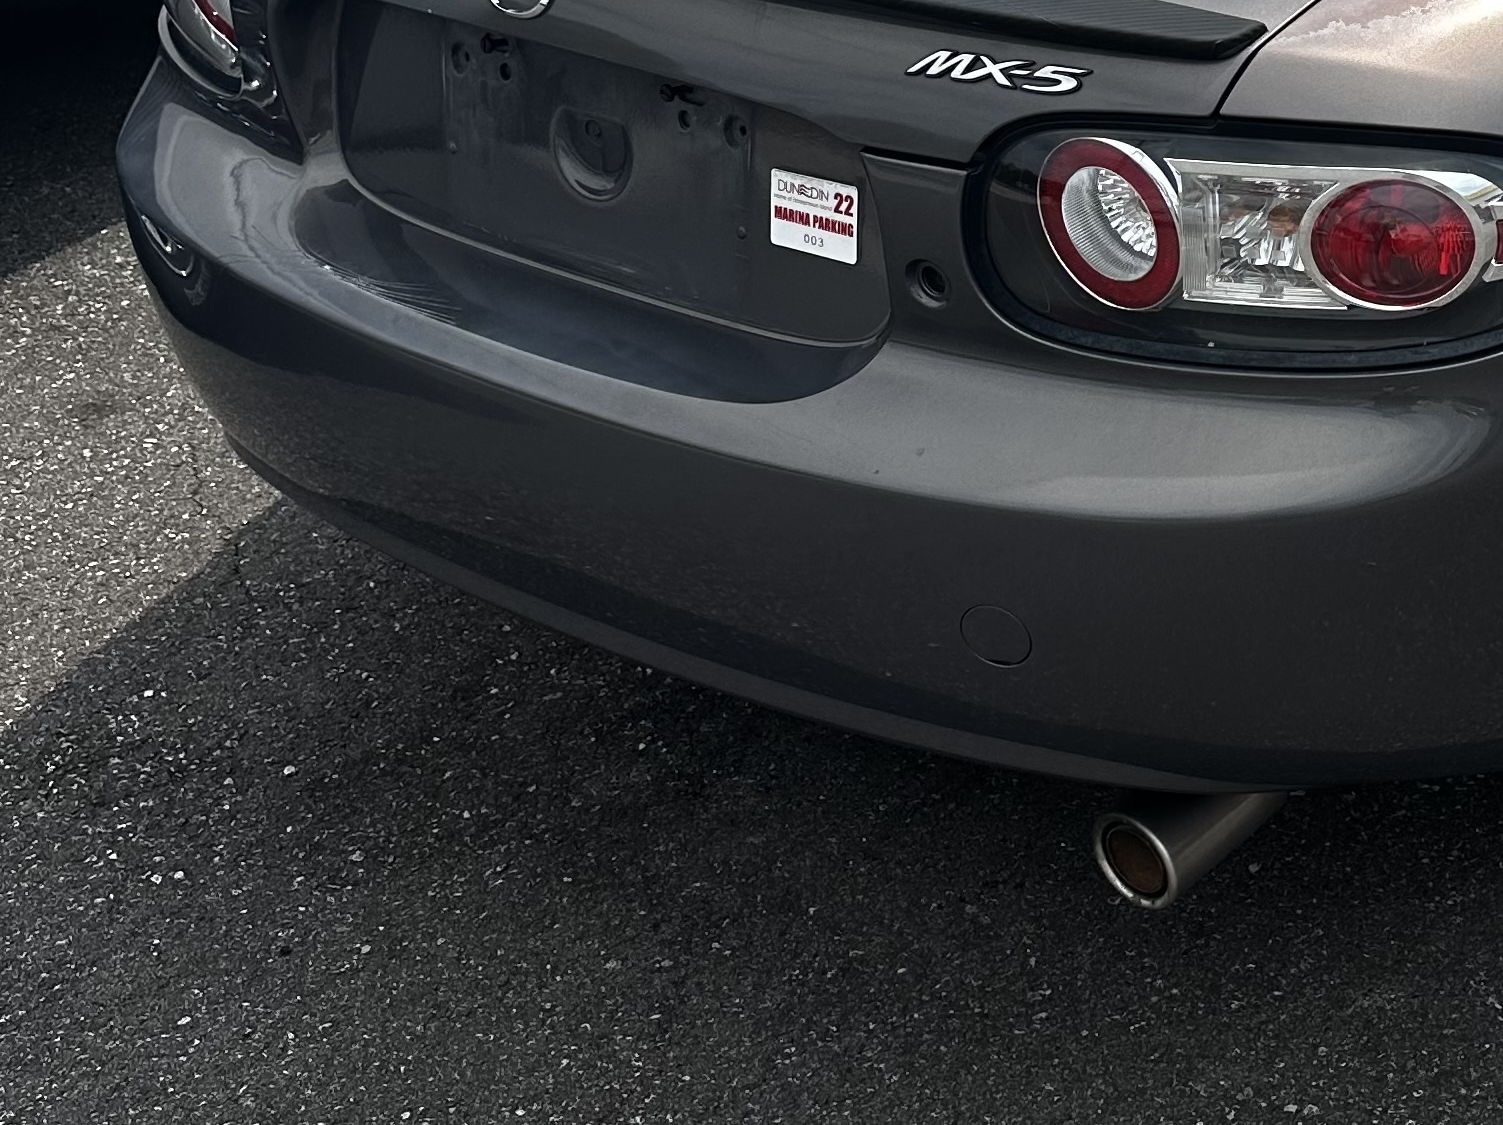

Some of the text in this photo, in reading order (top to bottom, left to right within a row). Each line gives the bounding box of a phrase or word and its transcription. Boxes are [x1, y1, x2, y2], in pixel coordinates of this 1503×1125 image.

[905, 49, 1093, 95] MX-5
[777, 178, 855, 217] DUNEDIN 22
[774, 205, 854, 237] MARINA PARKING
[803, 233, 824, 248] 003
